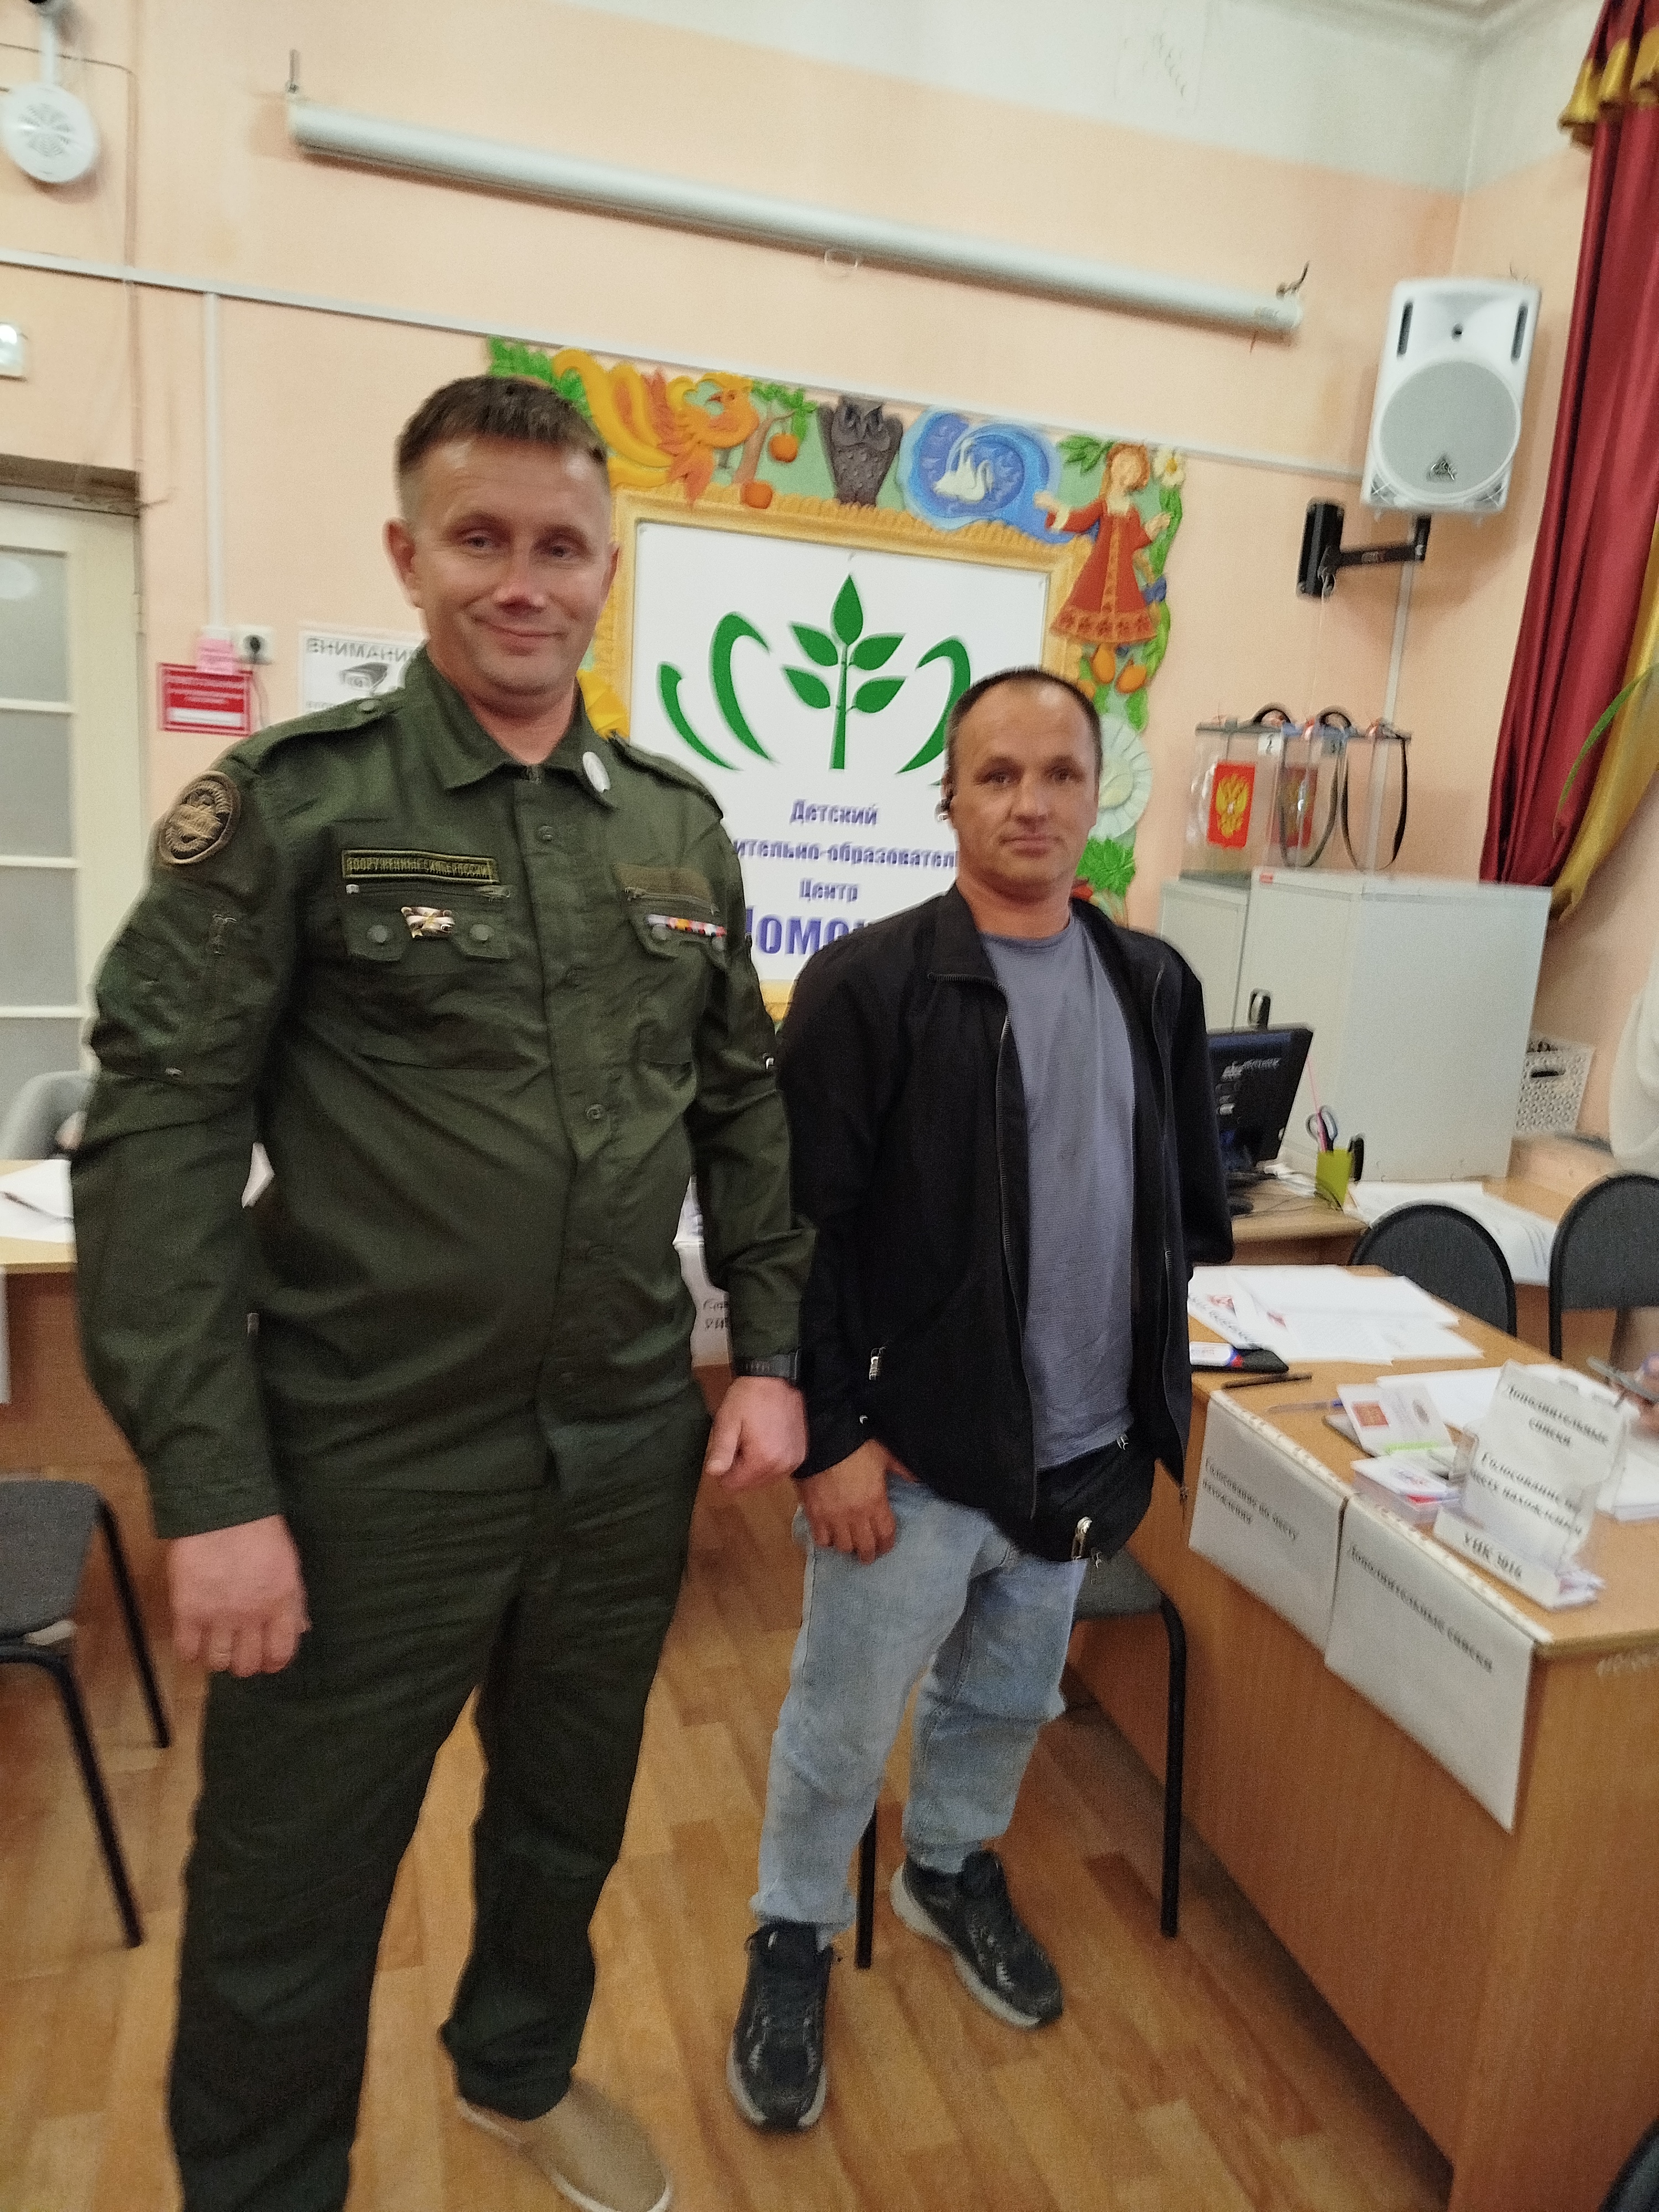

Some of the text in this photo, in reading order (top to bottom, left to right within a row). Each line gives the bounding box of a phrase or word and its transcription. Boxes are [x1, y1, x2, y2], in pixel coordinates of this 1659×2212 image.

[790, 800, 878, 825] Детский
[733, 839, 958, 870] ительно-образовател
[800, 878, 859, 902] Центр
